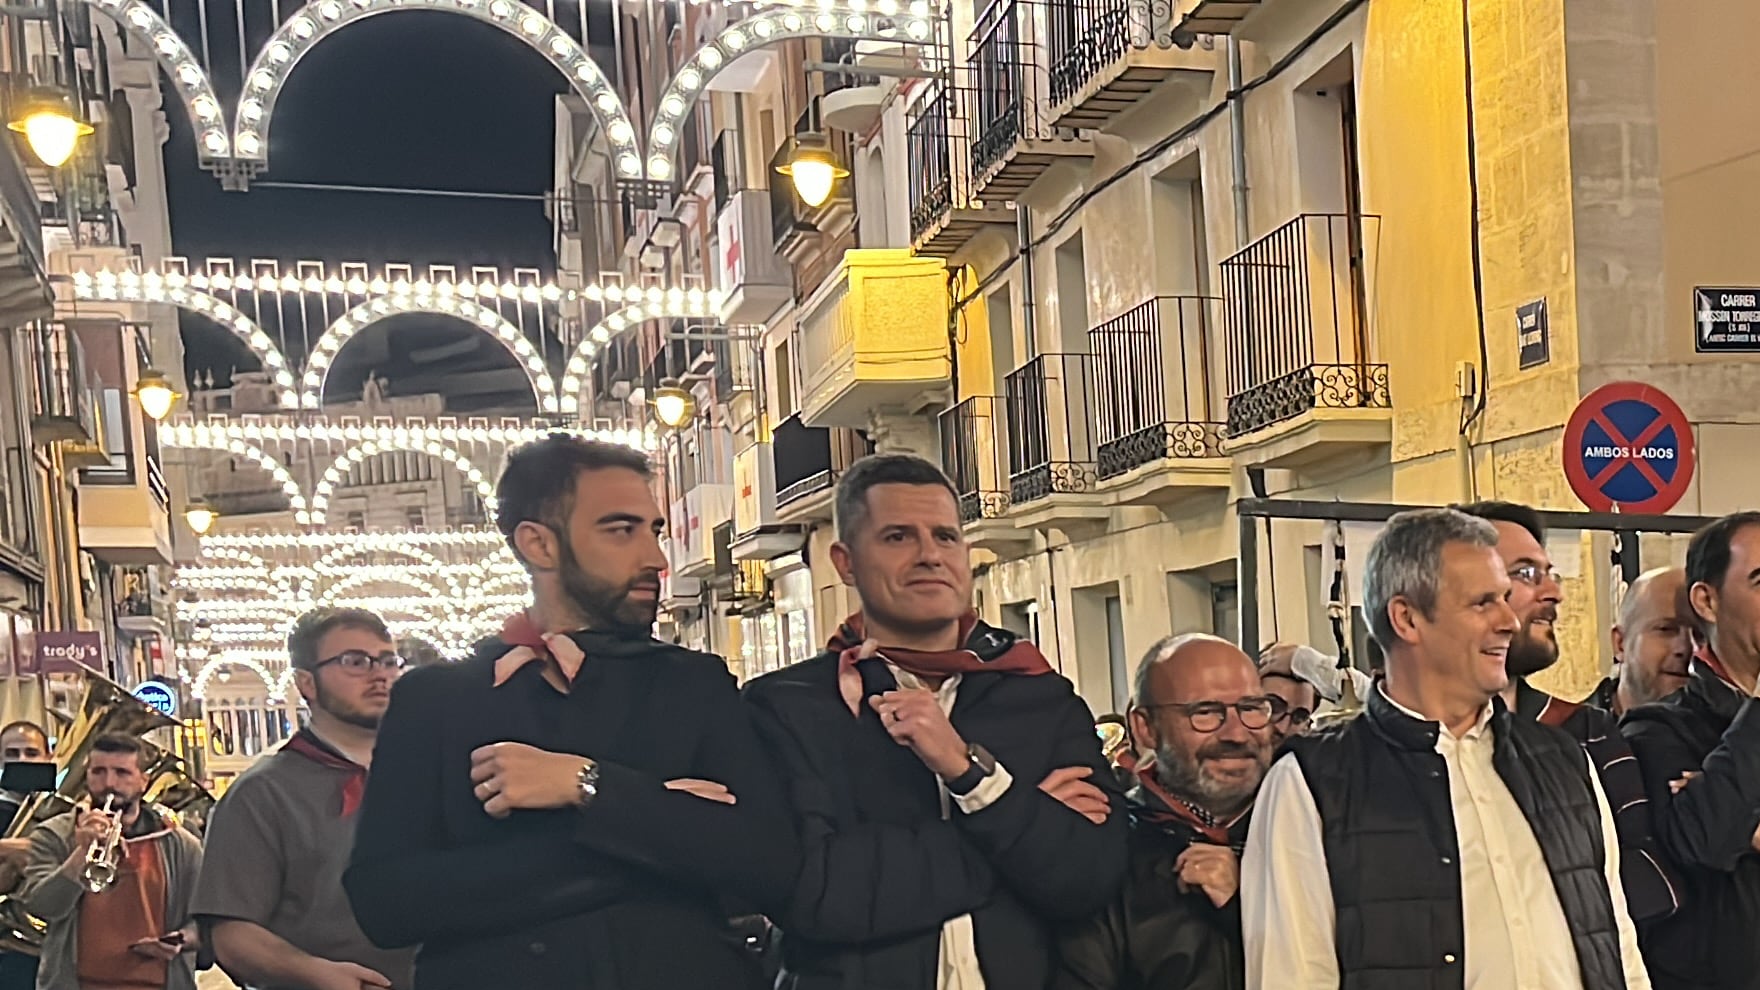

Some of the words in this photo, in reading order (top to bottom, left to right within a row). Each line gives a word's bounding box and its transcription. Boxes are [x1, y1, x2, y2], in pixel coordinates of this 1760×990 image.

[1720, 294, 1756, 307] CARRER
[1584, 446, 1630, 458] AMBOS
[1632, 447, 1674, 459] LADOS
